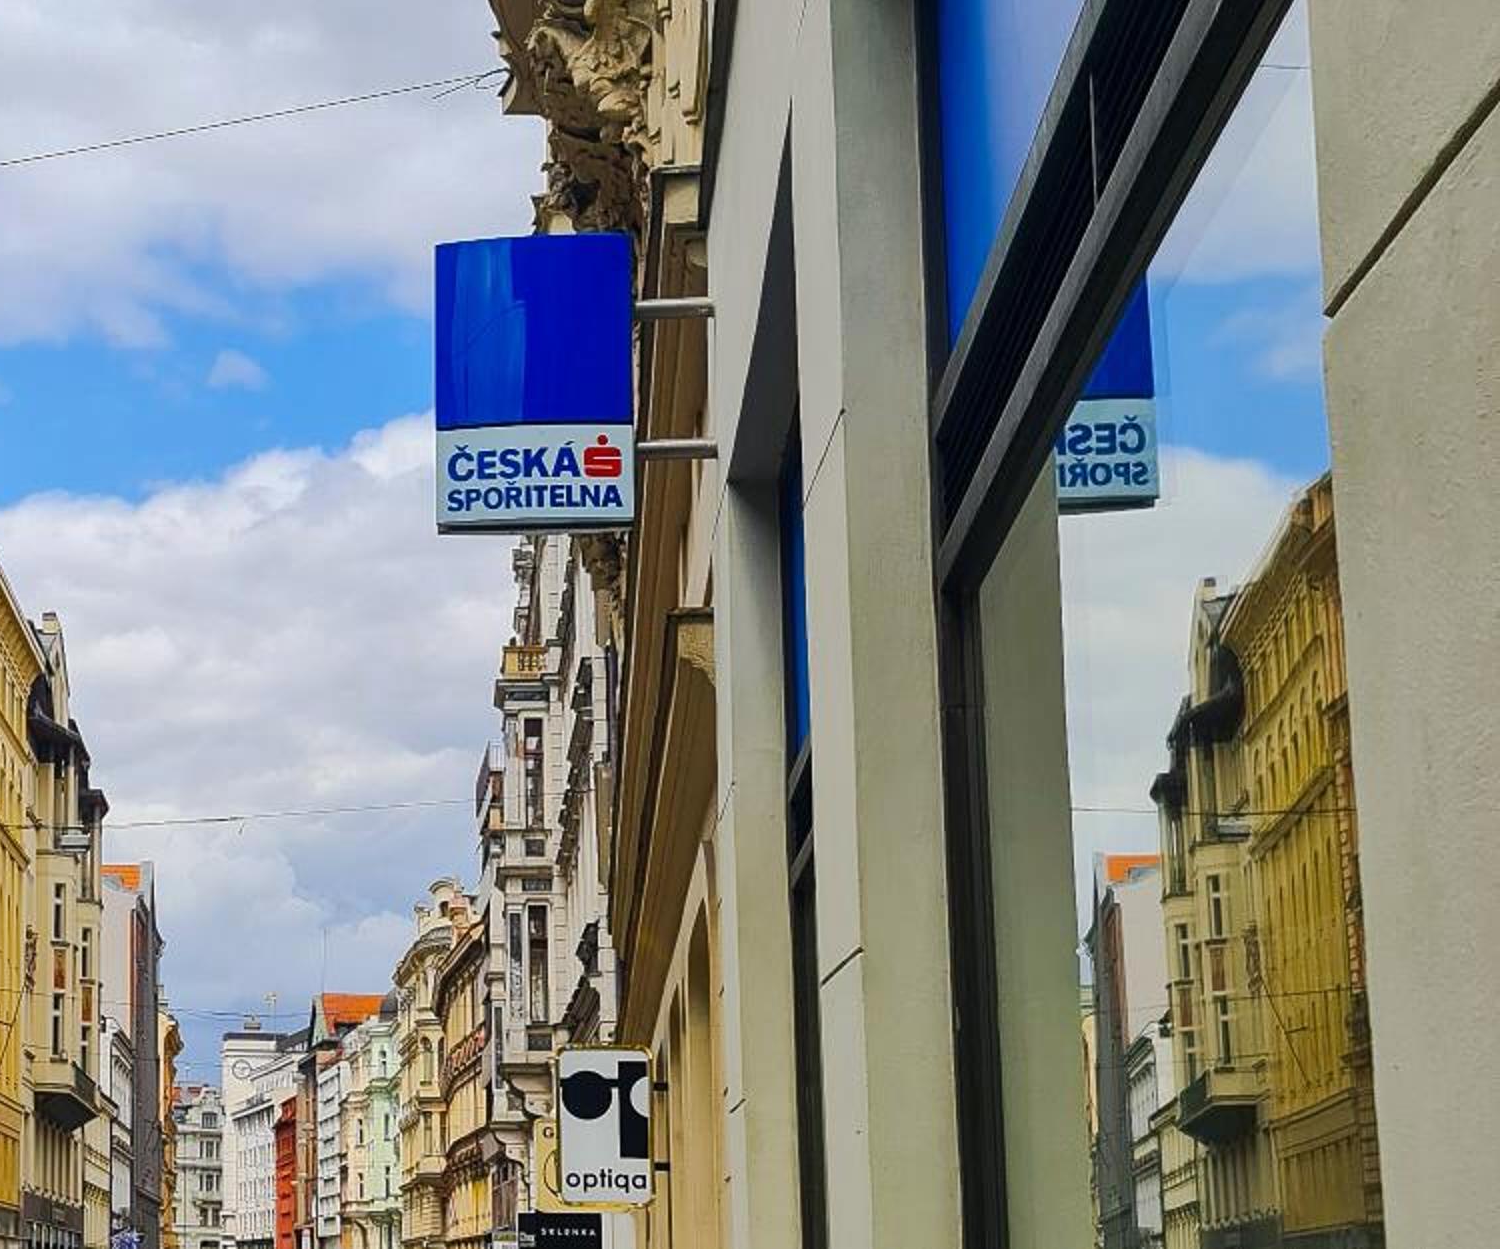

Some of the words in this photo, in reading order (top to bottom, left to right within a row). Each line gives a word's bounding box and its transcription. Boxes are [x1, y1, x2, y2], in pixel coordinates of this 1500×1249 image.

[447, 440, 580, 482] ČESKÁ
[447, 481, 623, 512] SPOŘITELNA
[566, 1168, 647, 1193] optiqa
